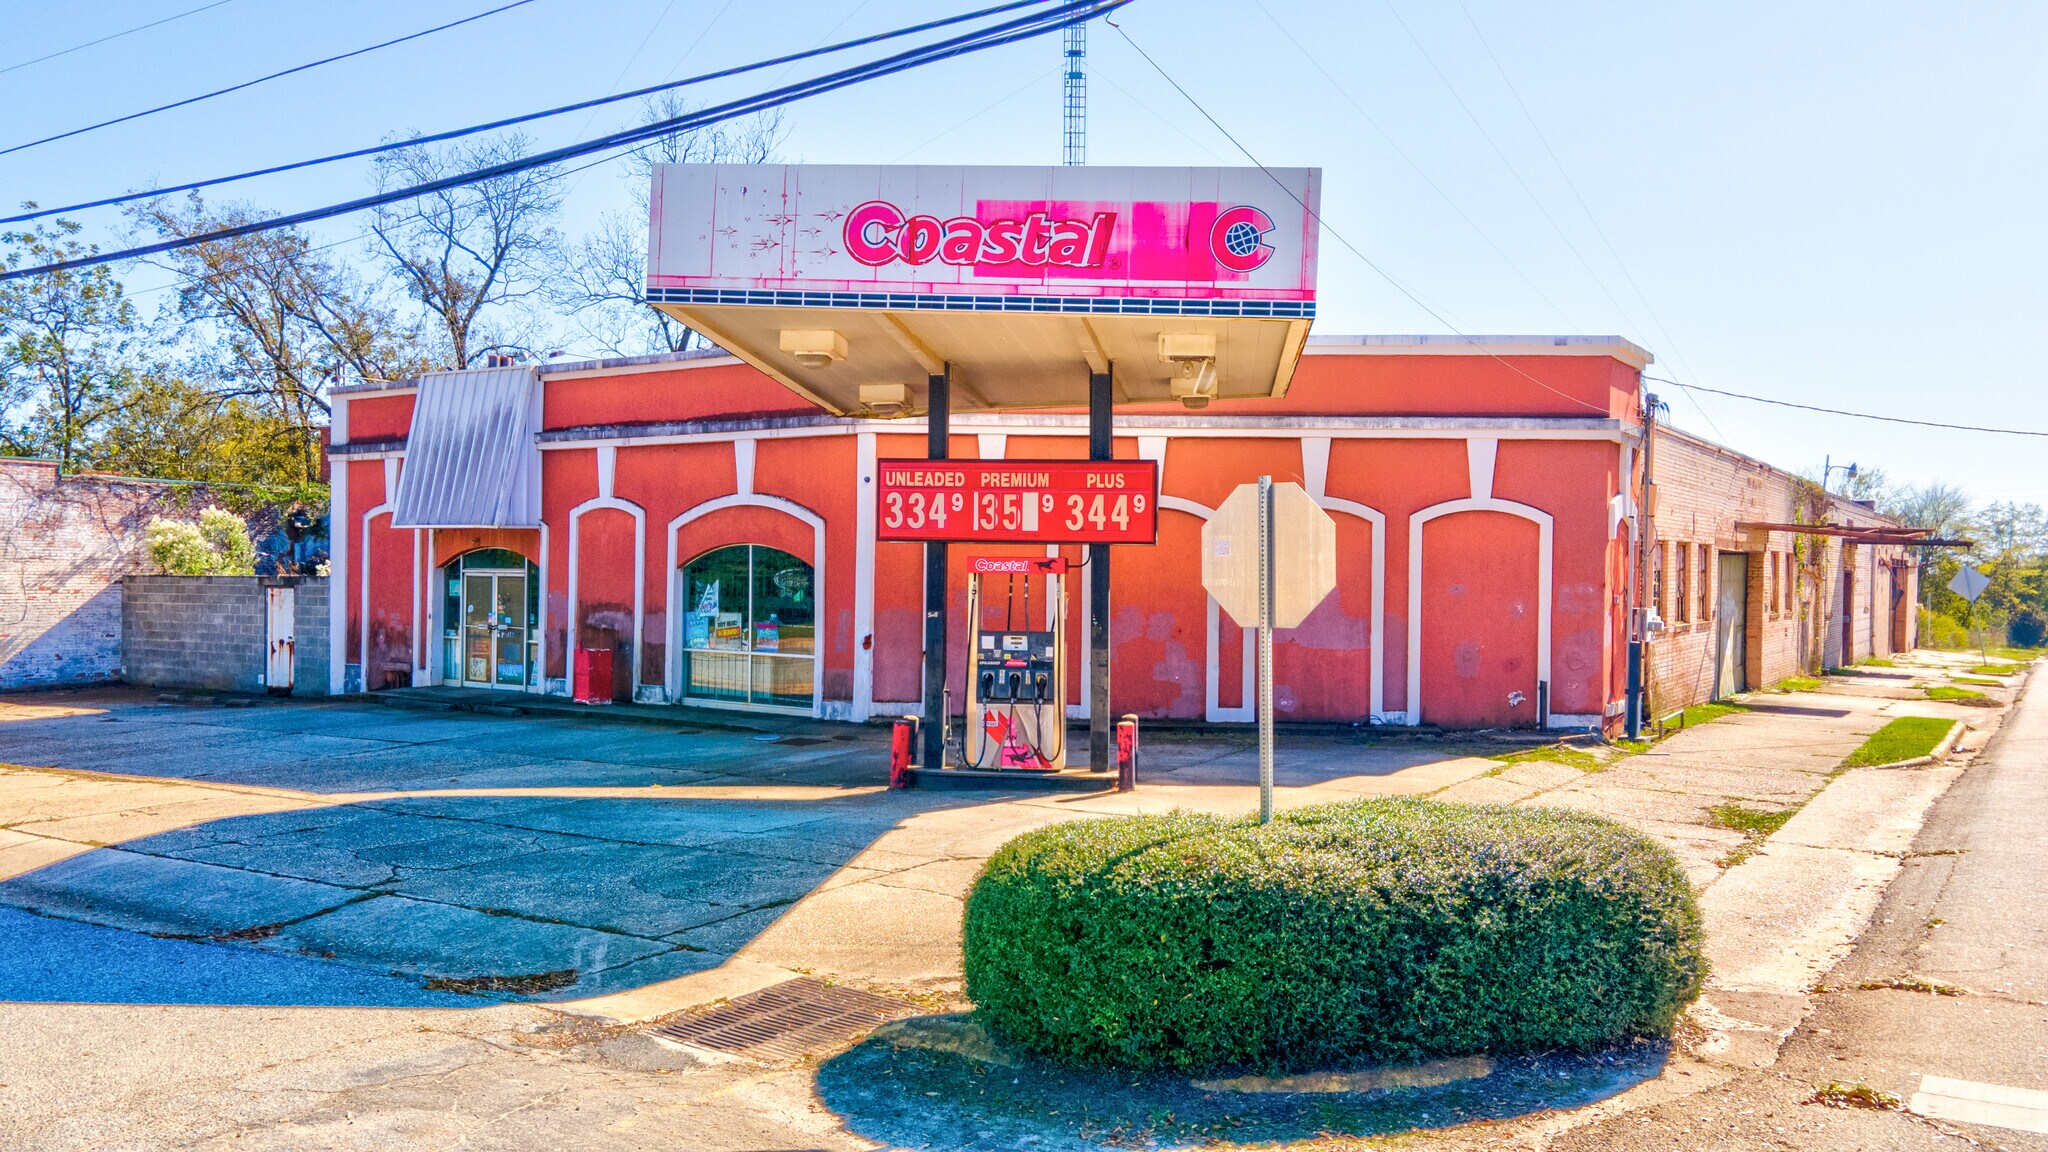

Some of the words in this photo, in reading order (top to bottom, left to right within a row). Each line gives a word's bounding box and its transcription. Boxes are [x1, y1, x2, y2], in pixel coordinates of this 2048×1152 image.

[843, 200, 1118, 267] Coastal
[885, 471, 965, 488] UNLEADED
[980, 472, 1050, 488] PREMIUM
[1086, 473, 1125, 489] PLUS
[975, 558, 1029, 572] Coastal
